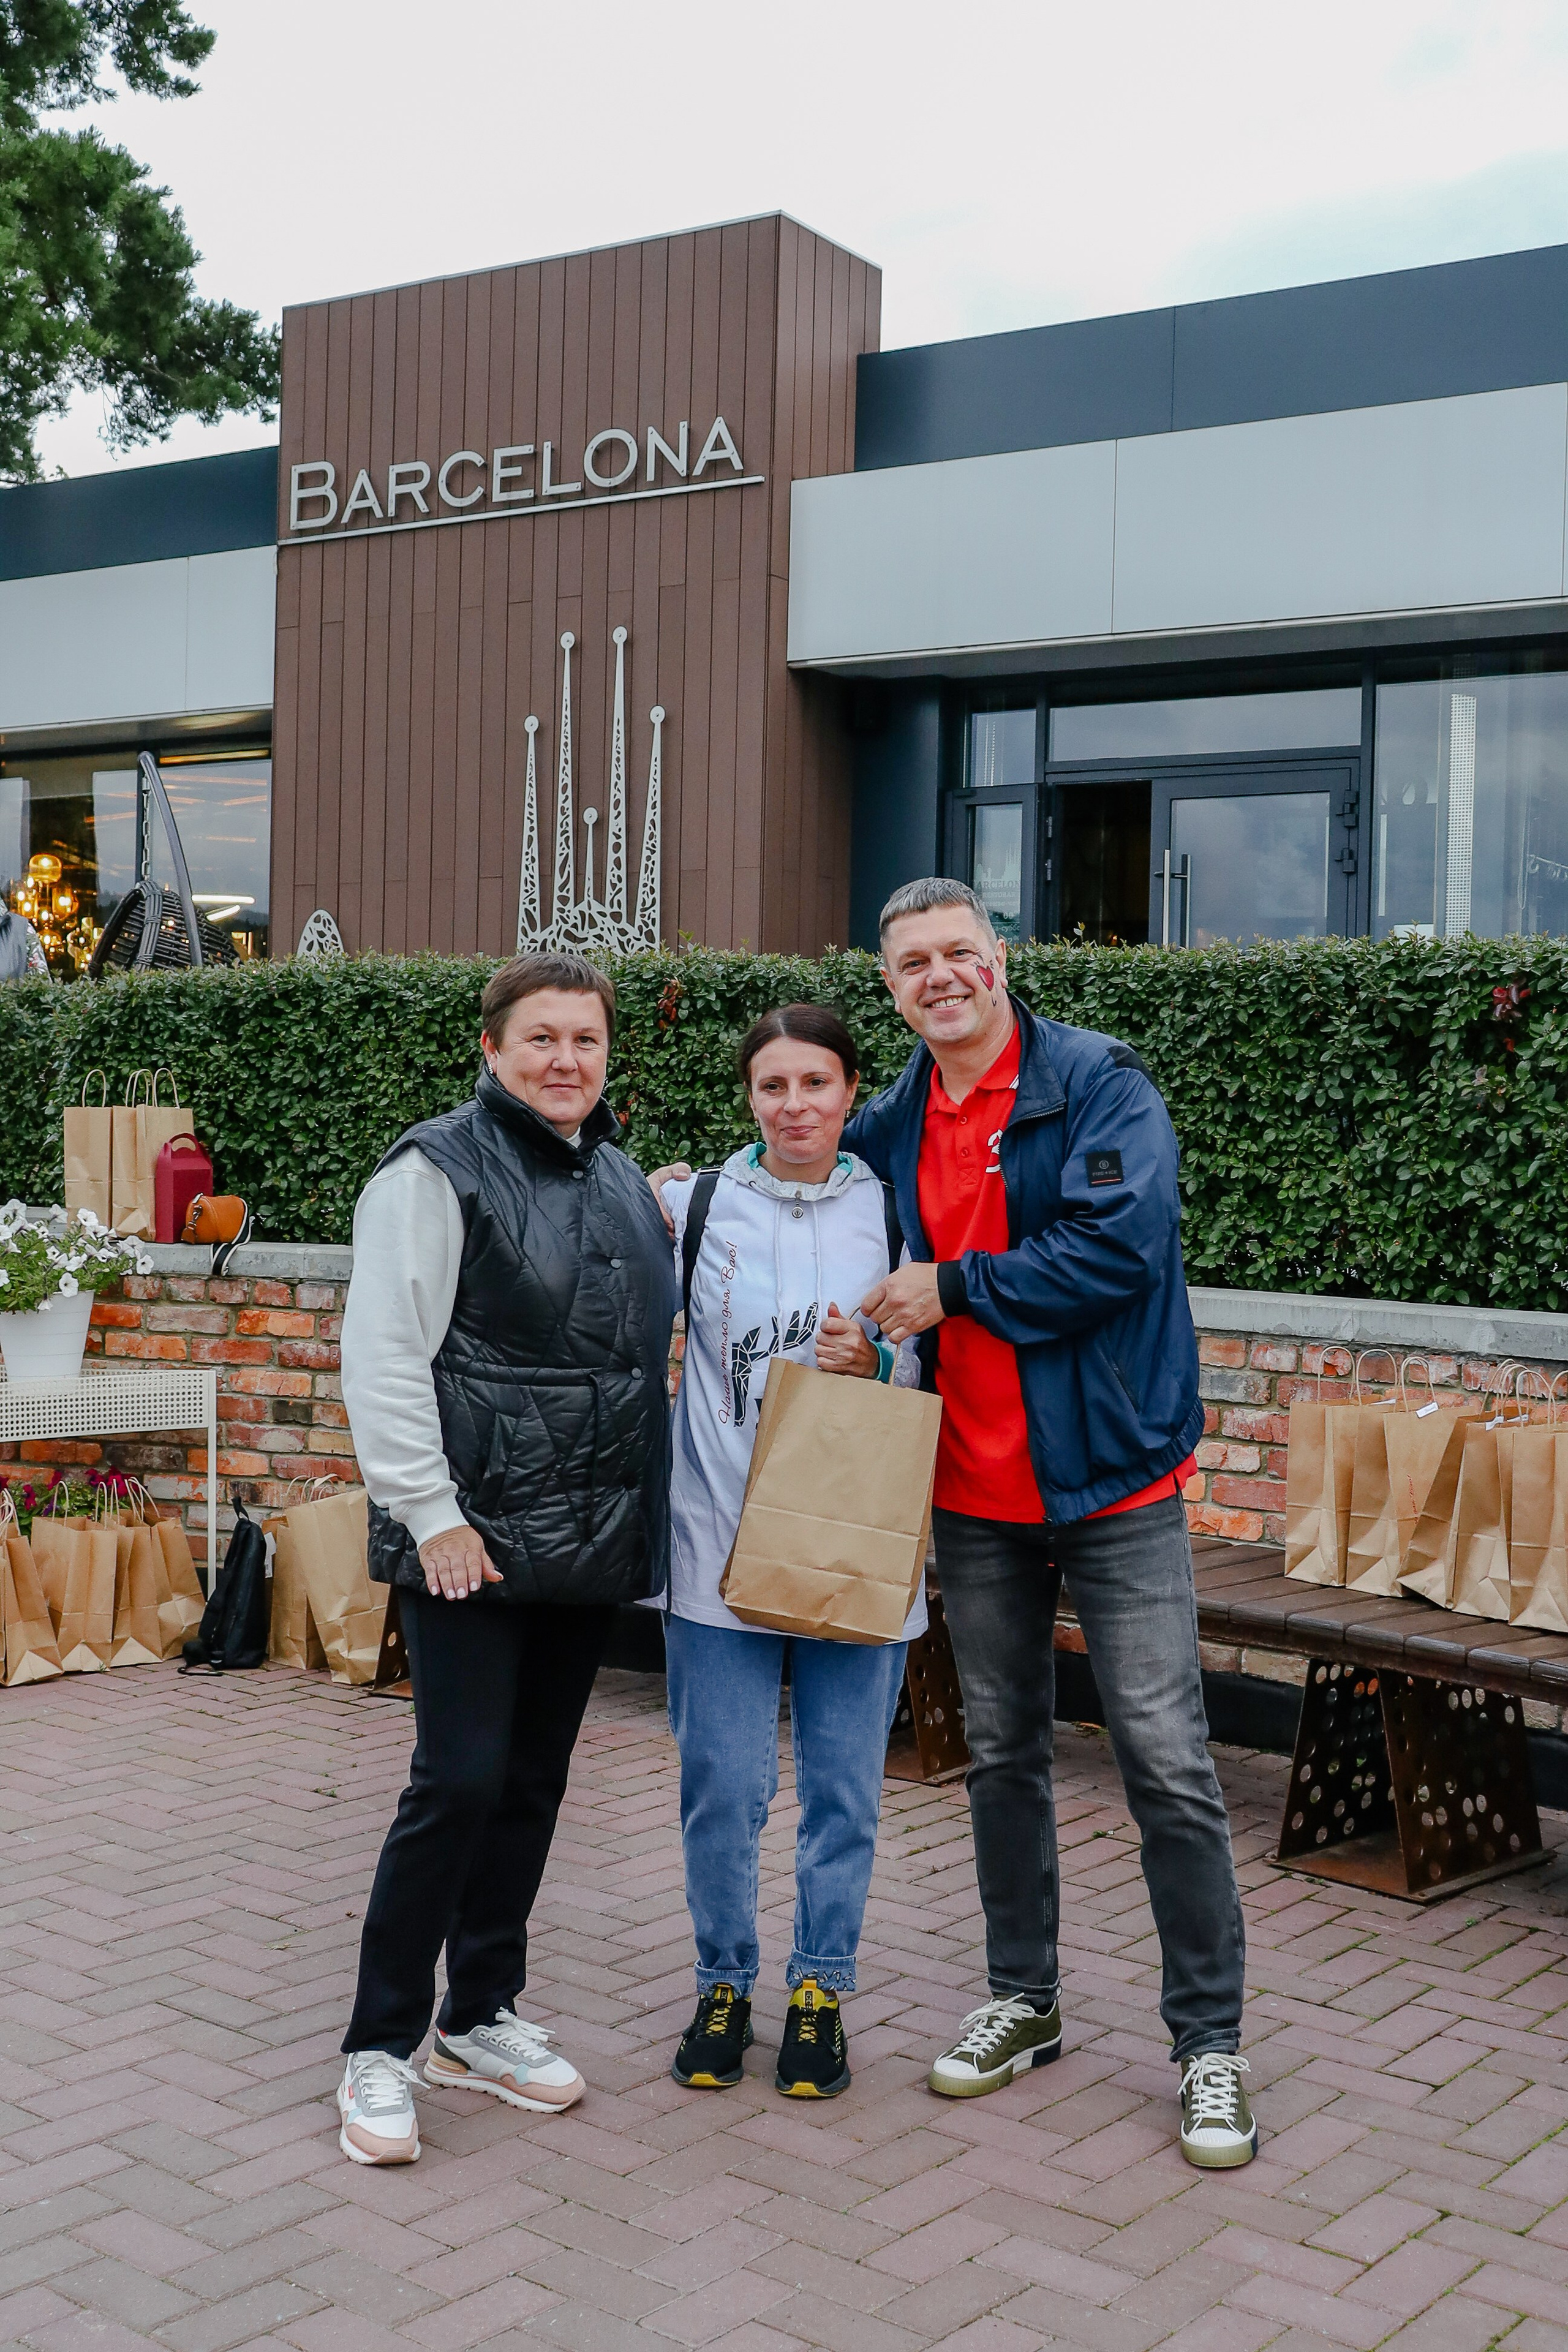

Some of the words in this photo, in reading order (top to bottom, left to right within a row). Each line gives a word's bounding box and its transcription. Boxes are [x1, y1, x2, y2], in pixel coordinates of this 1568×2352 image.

[290, 415, 744, 530] BARCELONA
[721, 1240, 737, 1284] Вас!
[720, 1288, 732, 1319] для
[720, 1322, 729, 1370] тепло
[718, 1374, 731, 1424] Наше
